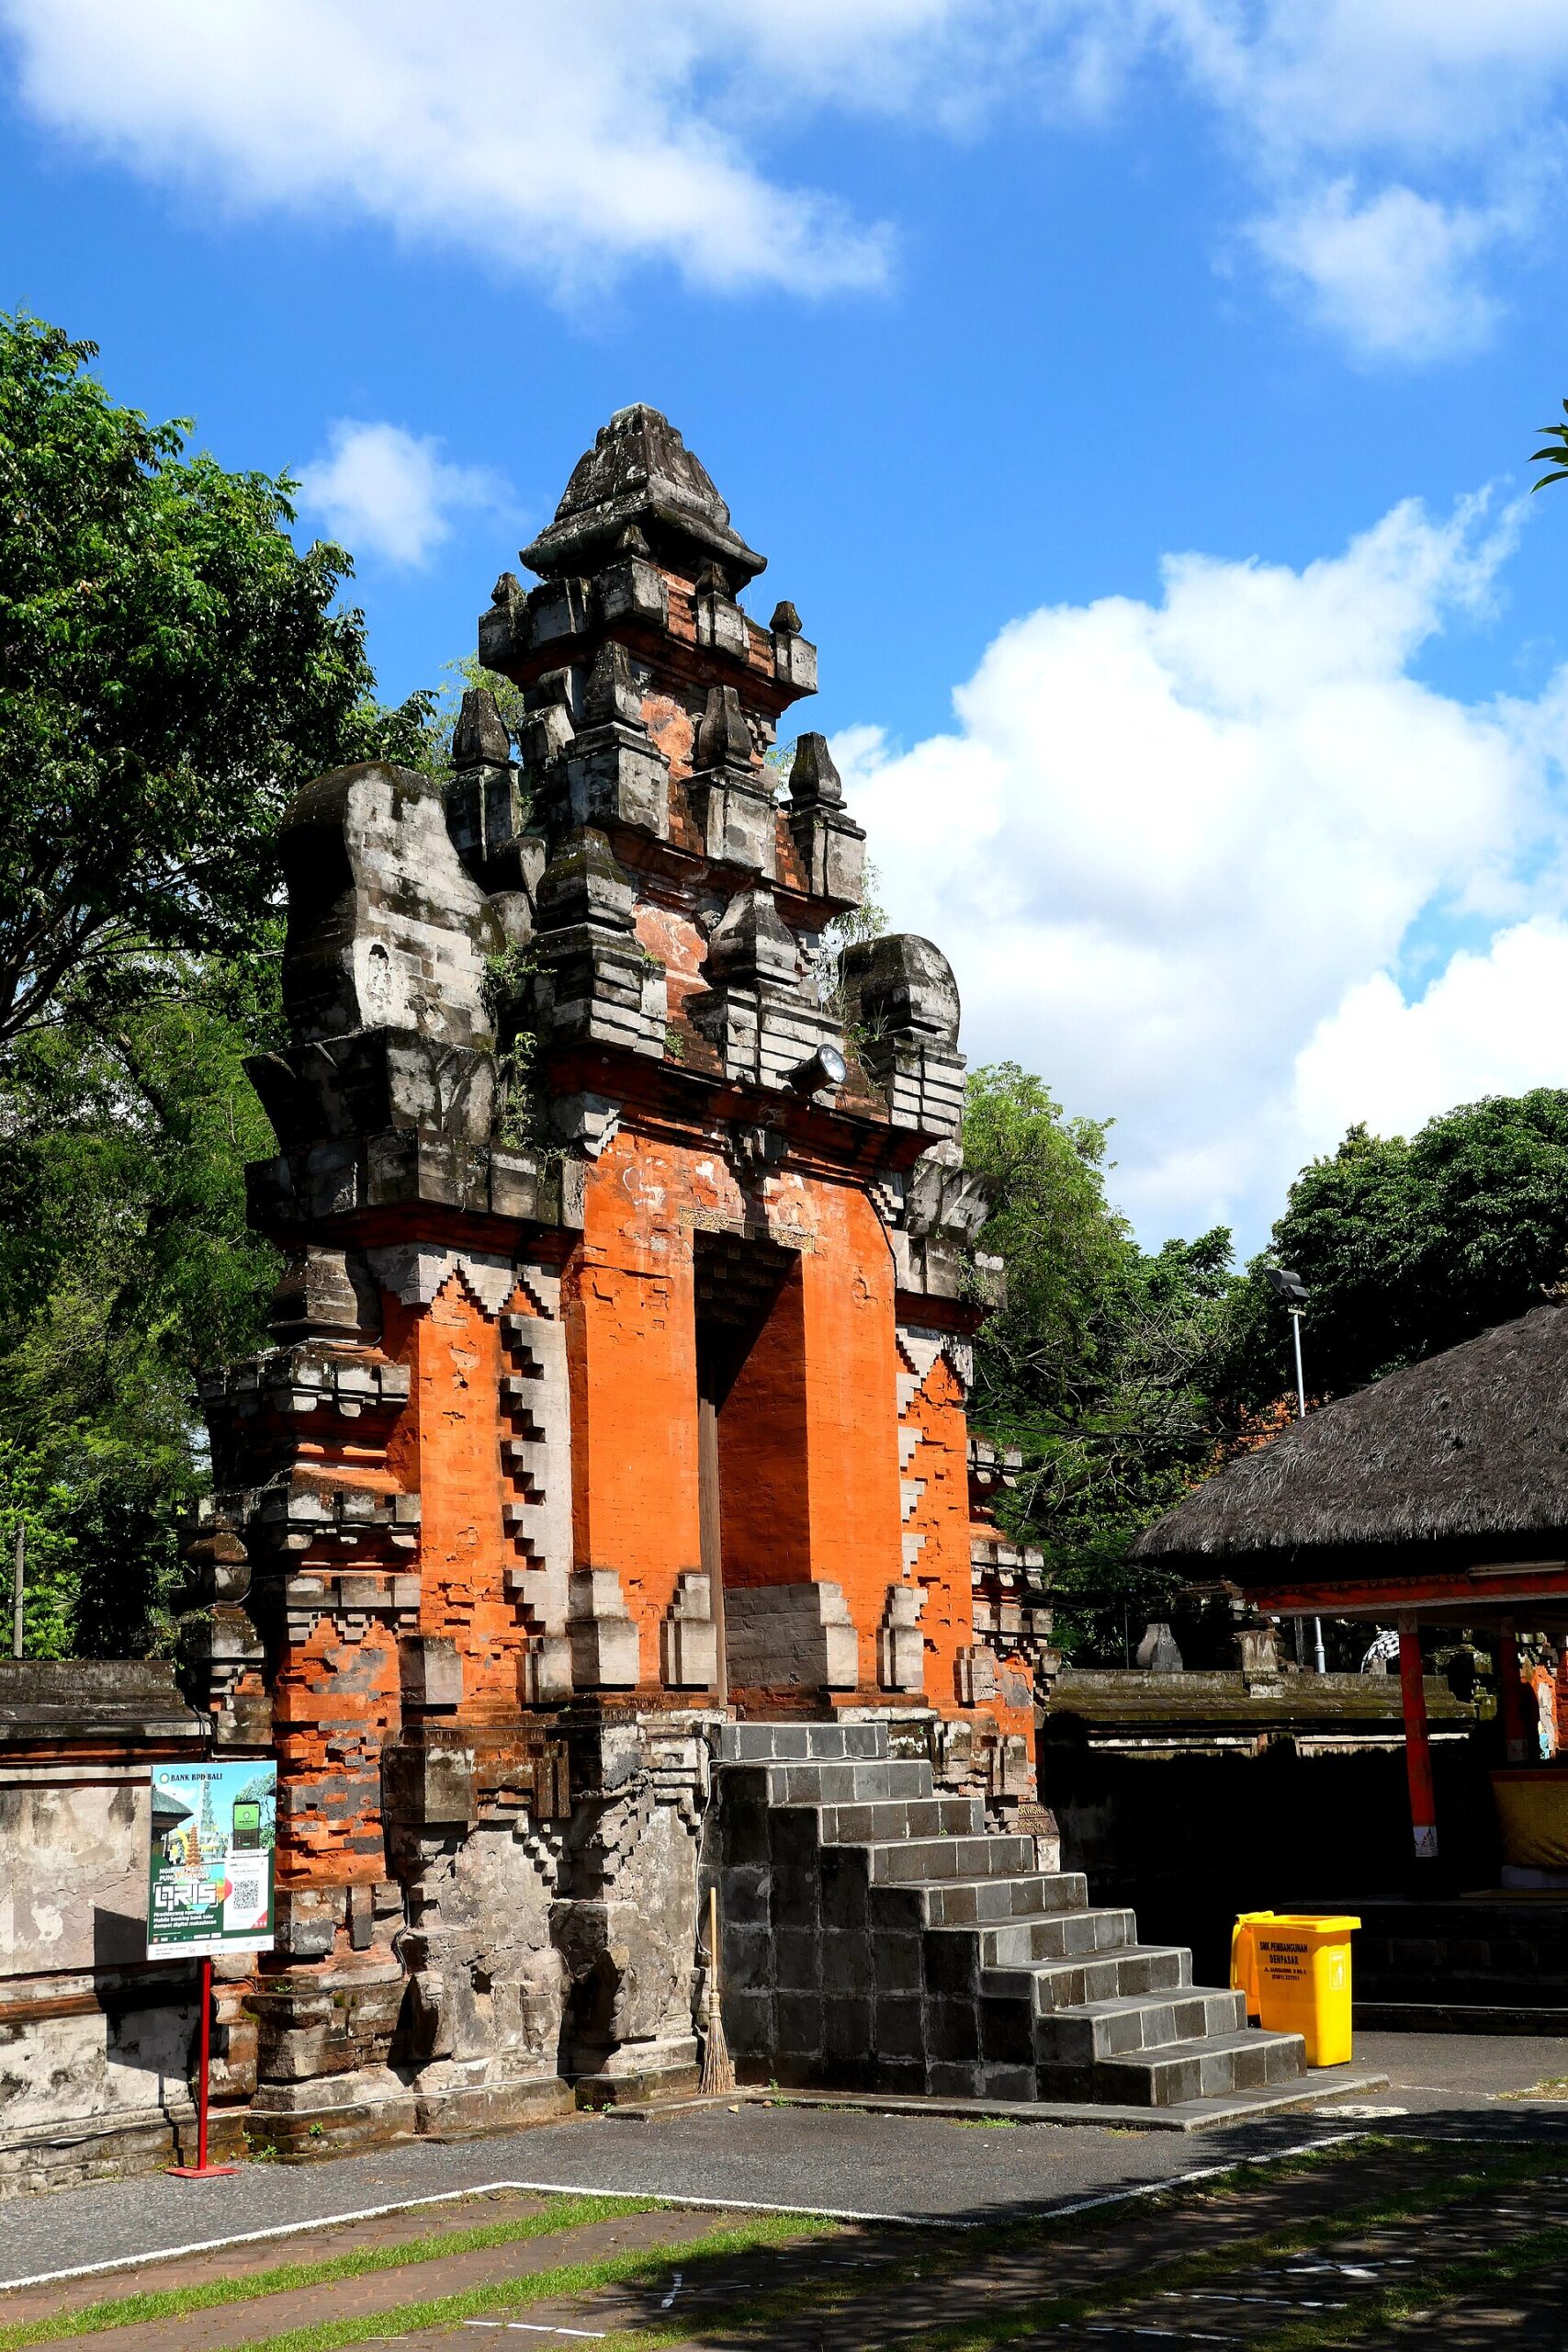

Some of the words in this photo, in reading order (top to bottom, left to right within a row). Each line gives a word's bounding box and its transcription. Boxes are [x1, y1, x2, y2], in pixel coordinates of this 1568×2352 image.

[155, 1883, 216, 1911] QRIS
[1259, 1941, 1269, 1951] SMK
[1270, 1941, 1308, 1953] PEMBANGUNAN
[1269, 1954, 1299, 1965] DENPASAR
